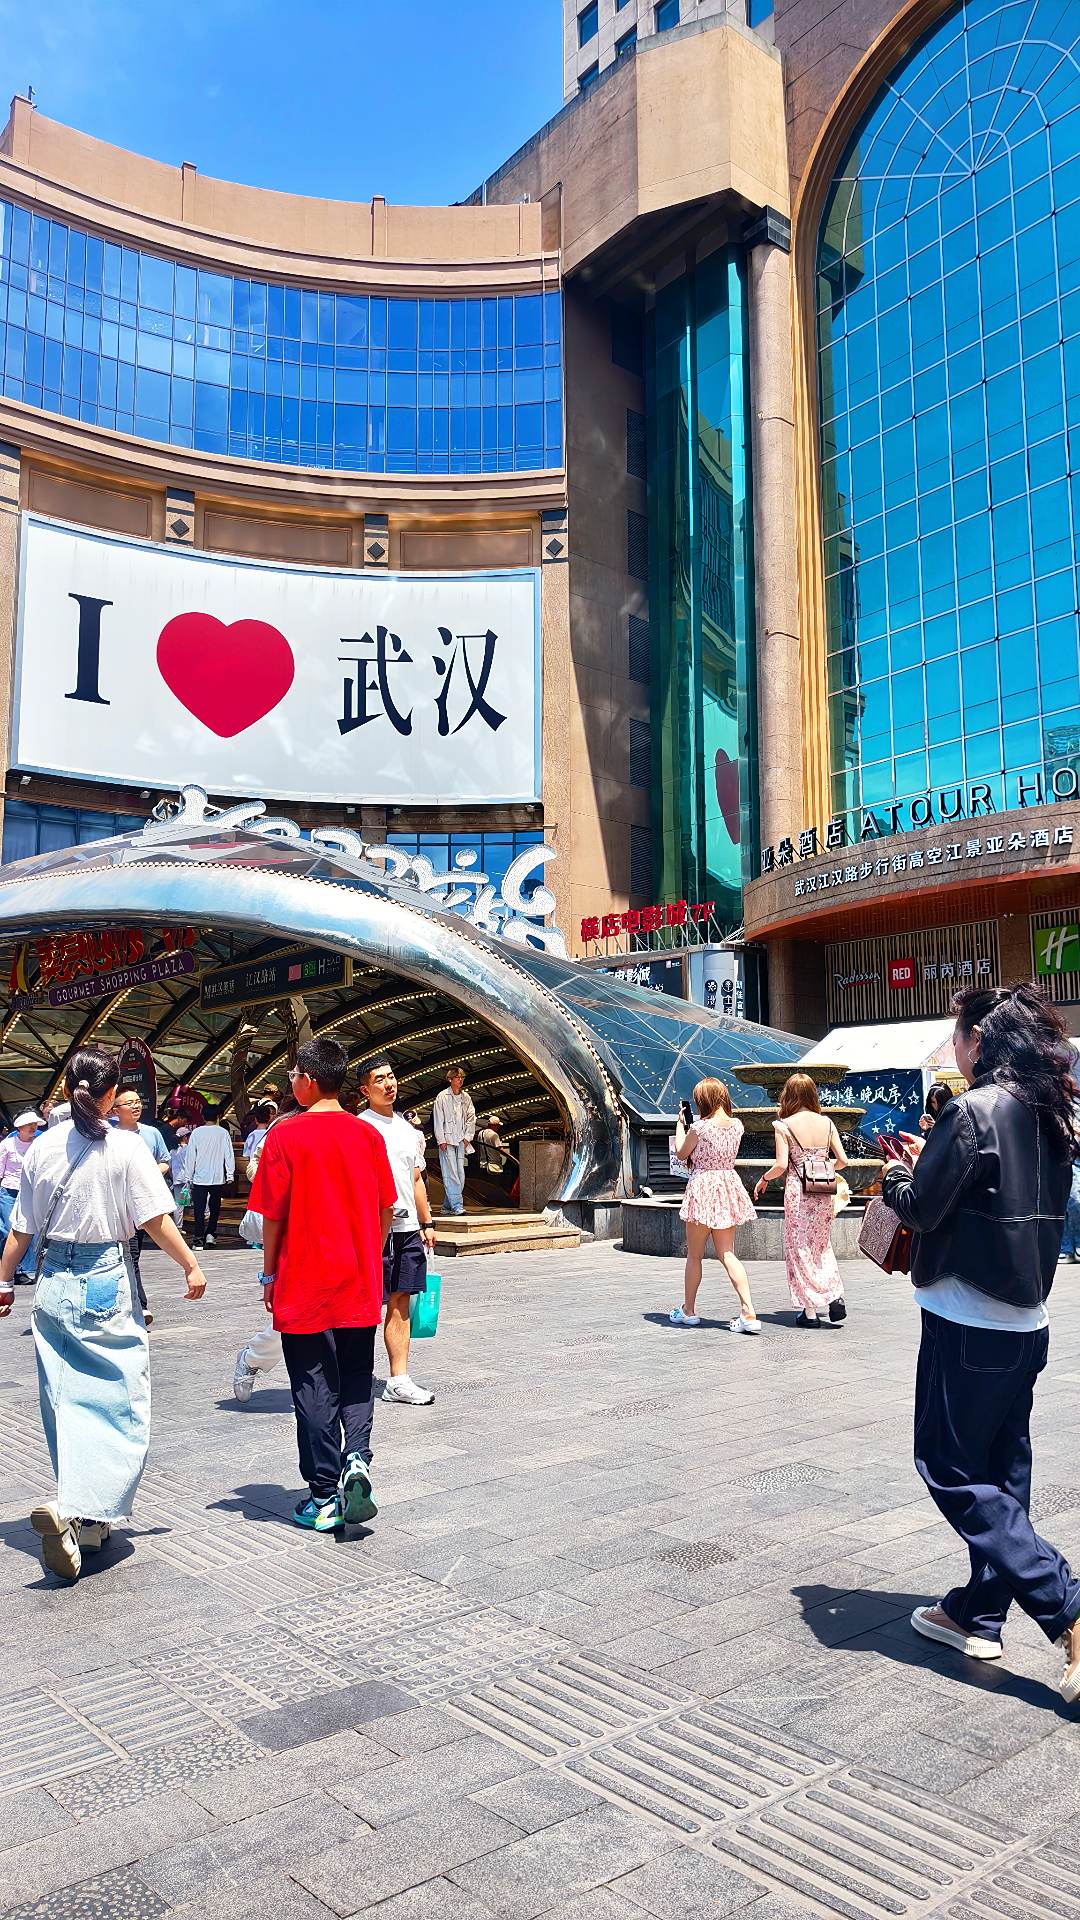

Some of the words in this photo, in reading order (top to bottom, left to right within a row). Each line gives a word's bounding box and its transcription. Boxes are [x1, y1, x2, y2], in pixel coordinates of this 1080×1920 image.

[65, 593, 113, 705] I
[337, 625, 507, 737] 武汉
[761, 819, 844, 873] 亚朵酒店
[859, 783, 992, 838] ATOUR
[793, 825, 1074, 897] 武汉江汉路步行街高空江景亚朵酒店
[56, 981, 96, 1002] GOURMET
[100, 968, 147, 992] SHOPPING
[152, 959, 185, 978] PLAZA
[833, 967, 881, 990] Radisson
[892, 967, 911, 981] RED
[923, 958, 991, 981] 丽芮酒店
